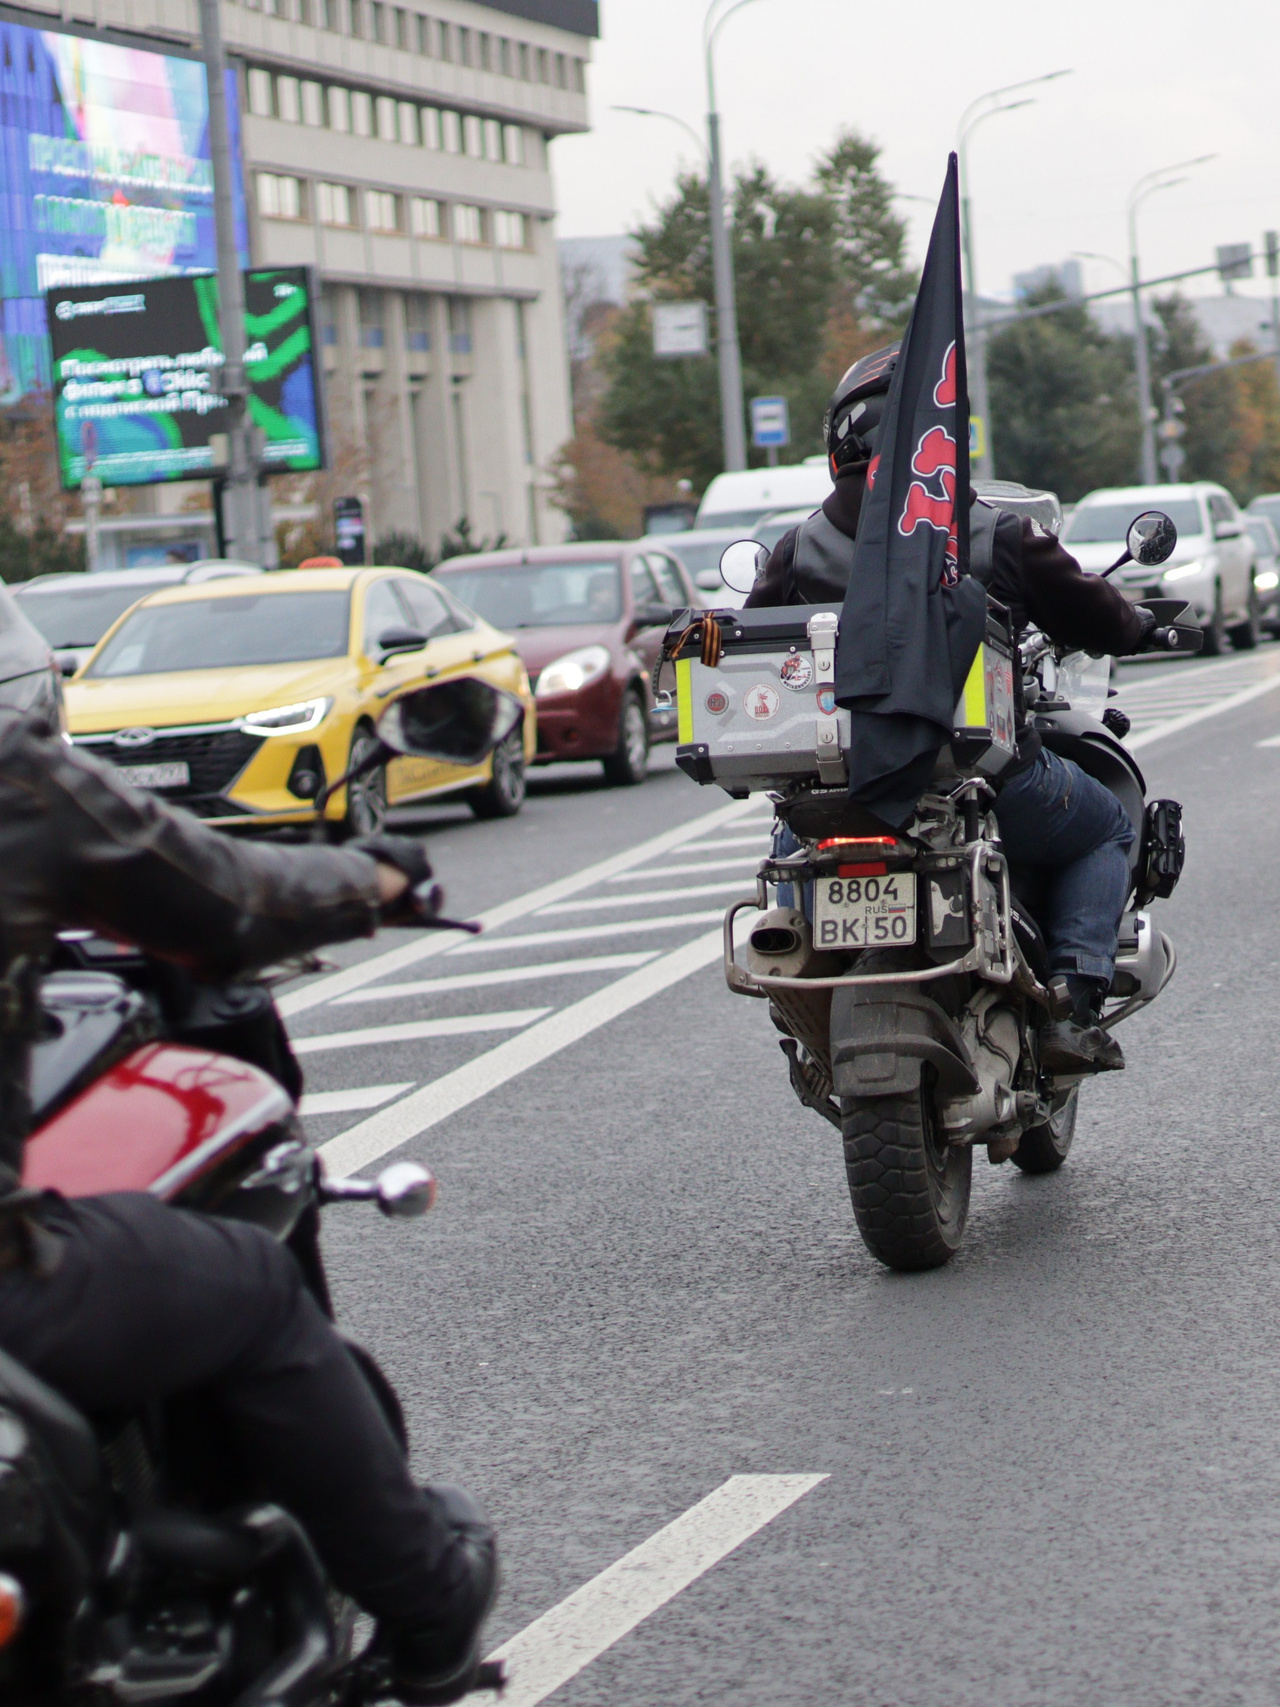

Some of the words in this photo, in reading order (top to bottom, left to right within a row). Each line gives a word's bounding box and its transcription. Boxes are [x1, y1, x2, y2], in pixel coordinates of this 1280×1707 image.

[828, 877, 898, 904] 8804
[865, 905, 888, 914] RUS
[874, 916, 907, 940] 50
